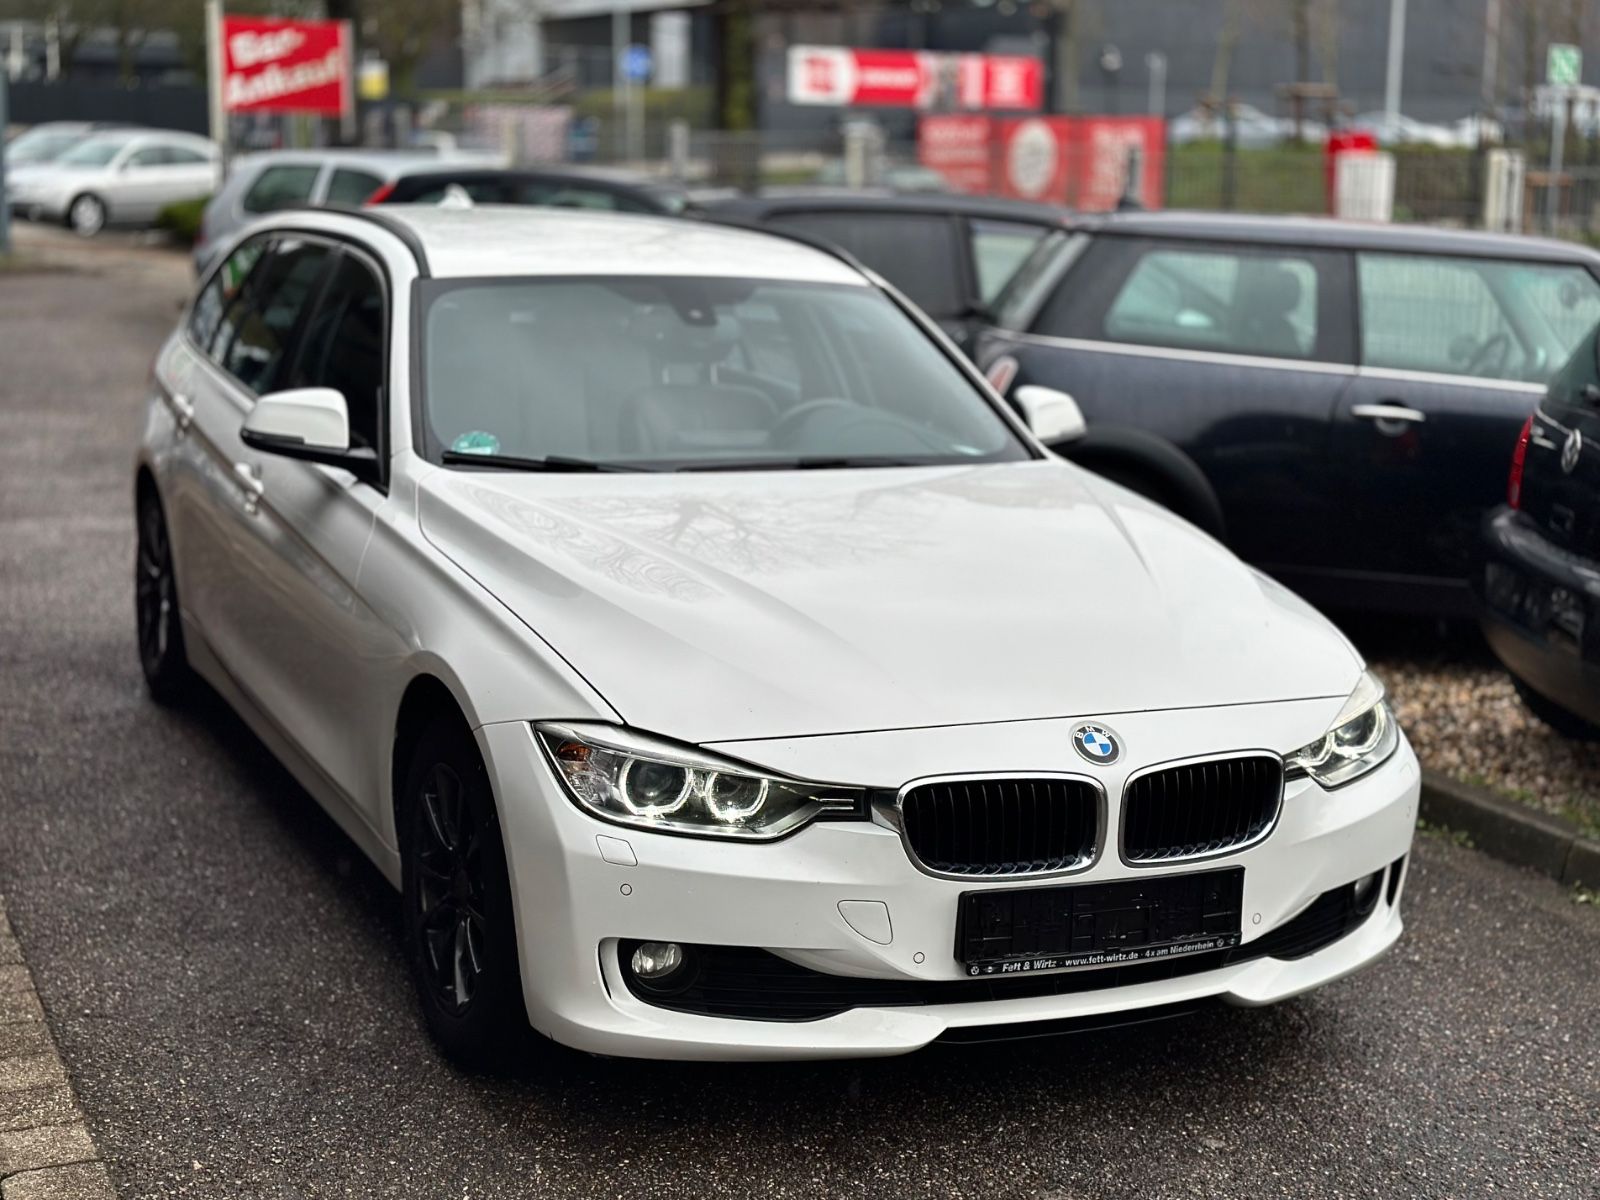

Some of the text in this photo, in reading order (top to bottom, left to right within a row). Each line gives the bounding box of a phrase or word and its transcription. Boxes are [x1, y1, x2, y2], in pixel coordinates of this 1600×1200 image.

[224, 47, 341, 107] Ankauf
[1075, 726, 1111, 739] BMW
[1002, 962, 1021, 973] Fett
[1023, 961, 1030, 971] &
[1033, 960, 1057, 970] Wirtz
[1065, 951, 1139, 966] www.fett-wirtz.de
[1156, 949, 1169, 957] am
[1169, 941, 1214, 955] Niederrhein
